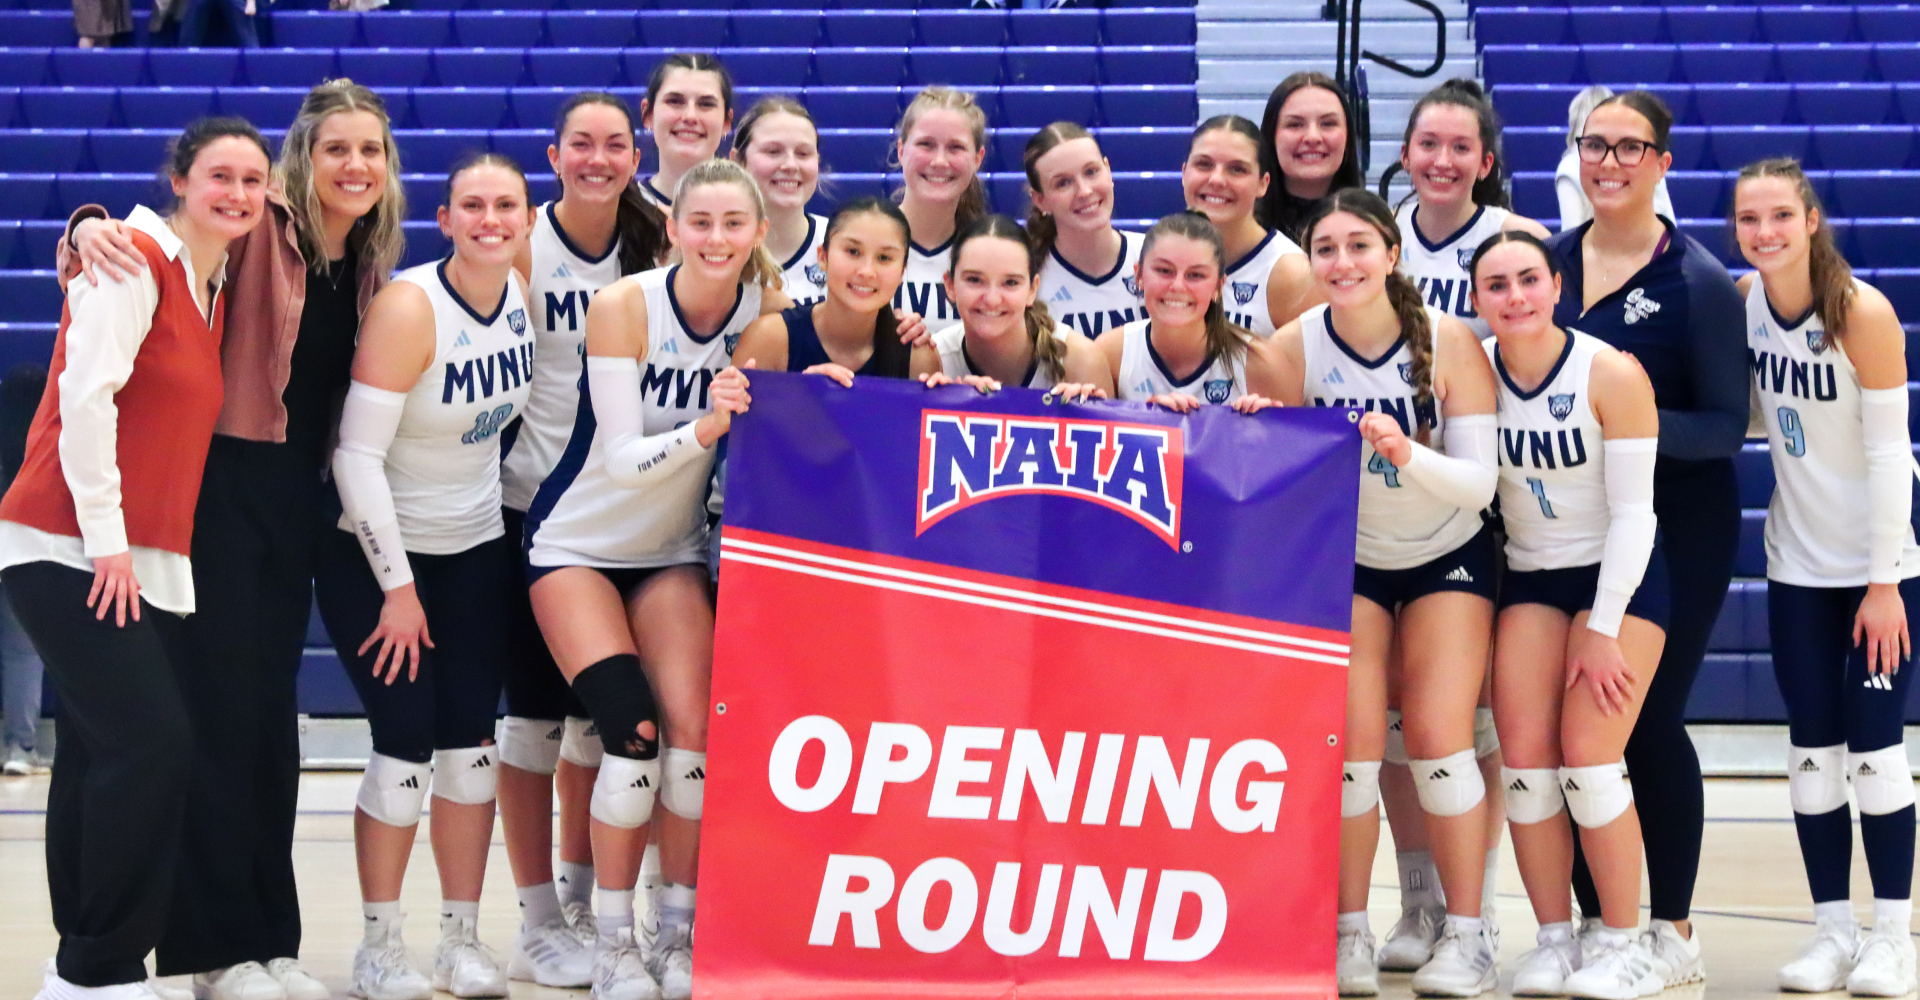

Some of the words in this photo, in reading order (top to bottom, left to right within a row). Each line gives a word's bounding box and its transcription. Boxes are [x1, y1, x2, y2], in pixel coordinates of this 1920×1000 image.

[441, 341, 535, 405] MVNU
[1750, 347, 1838, 401] MVNU
[1497, 426, 1588, 470] VNU
[1777, 406, 1806, 458] 9
[922, 414, 1176, 539] NAIA
[1367, 450, 1403, 488] 4
[1525, 476, 1558, 519] 1
[769, 715, 1289, 834] OPENING
[807, 854, 1229, 963] ROUND
